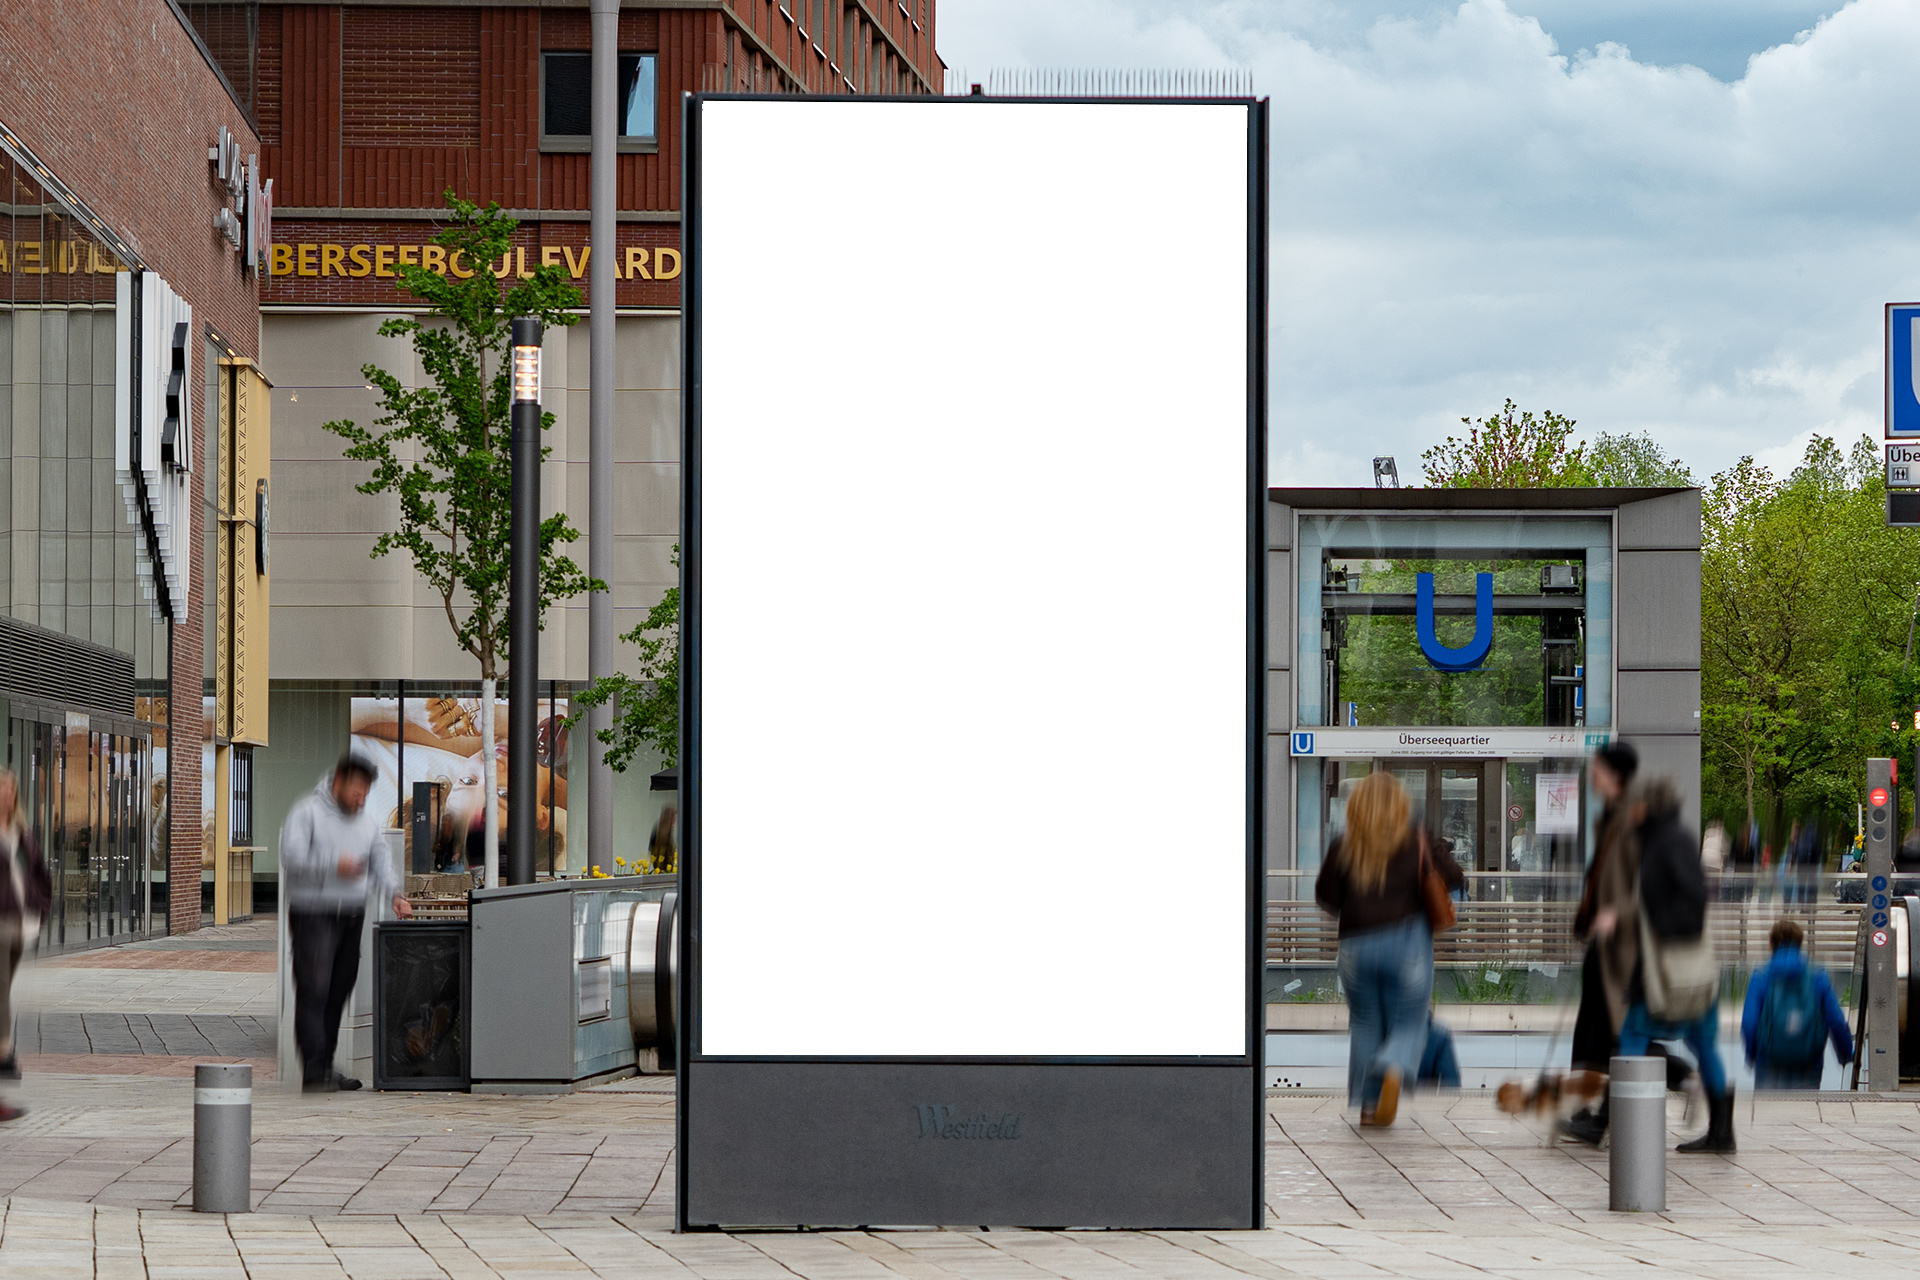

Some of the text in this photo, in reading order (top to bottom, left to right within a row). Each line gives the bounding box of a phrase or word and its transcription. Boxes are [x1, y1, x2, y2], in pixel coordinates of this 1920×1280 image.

[259, 243, 682, 281] BERSEEBOULEVRD
[1416, 572, 1493, 673] U
[1295, 734, 1311, 753] U
[1399, 733, 1490, 747] Überseequartier
[913, 1103, 1025, 1140] Westfield
